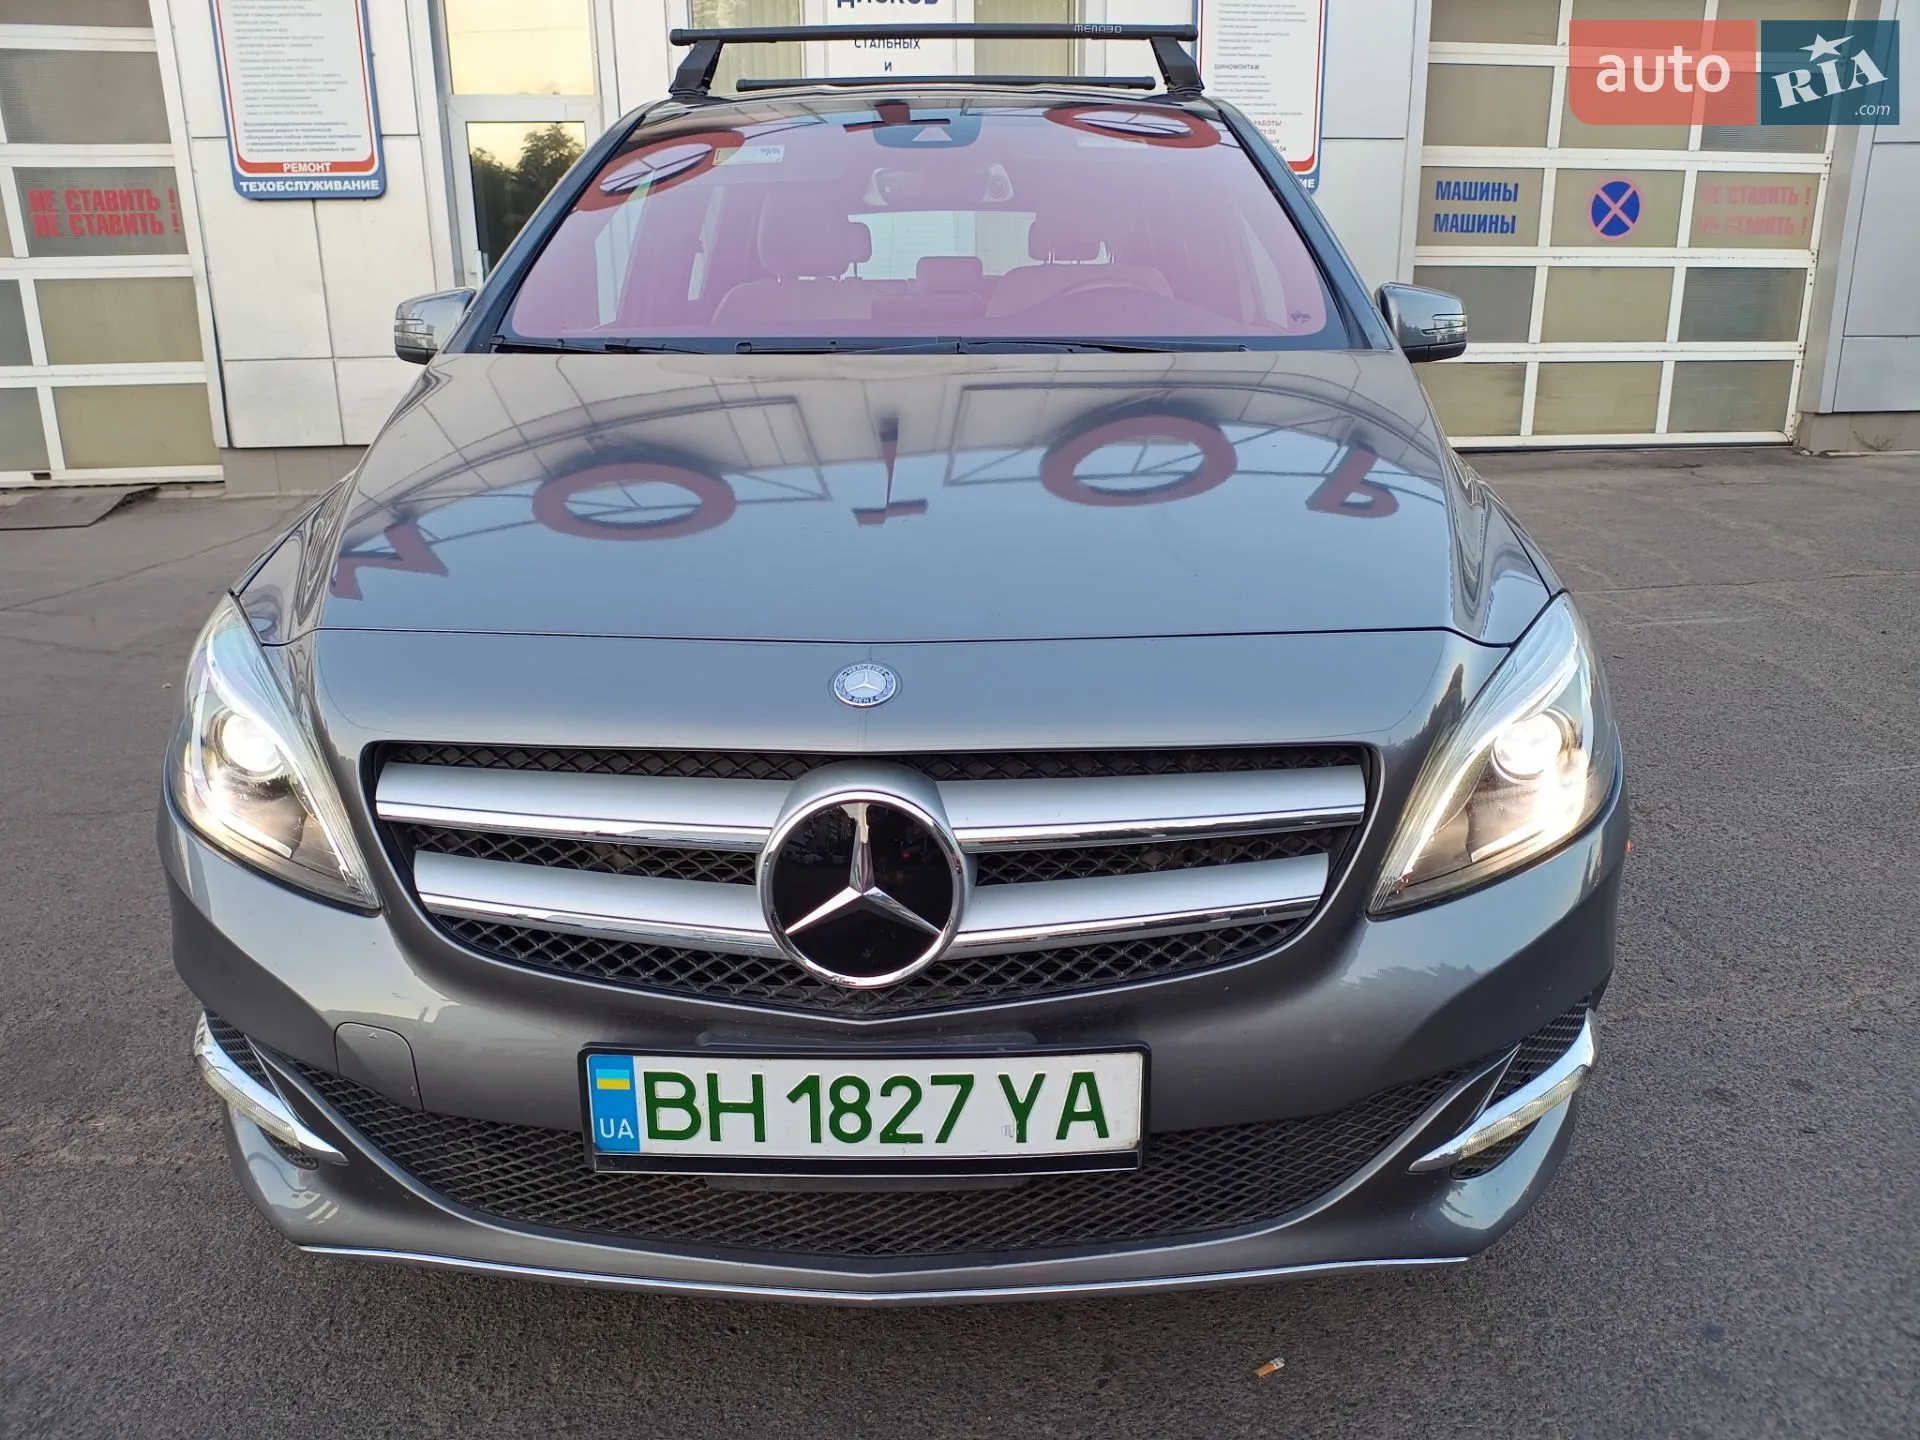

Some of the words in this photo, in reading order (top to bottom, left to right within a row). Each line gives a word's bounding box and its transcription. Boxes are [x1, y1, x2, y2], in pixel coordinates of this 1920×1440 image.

[1074, 24, 1122, 34] MENABO
[283, 162, 332, 173] РЕМОНТ
[239, 179, 380, 192] ТЕХОБСЛУЖИВАНИЕ
[1435, 180, 1519, 202] МАШИНЫ
[64, 188, 161, 212] СТАВИТЬ
[68, 213, 165, 237] СТАВИТЬ
[1433, 213, 1517, 234] МАШИНЫ
[600, 1117, 635, 1141] UA
[643, 1070, 766, 1143] BH
[786, 1073, 976, 1144] 1827
[998, 1070, 1110, 1143] YA
